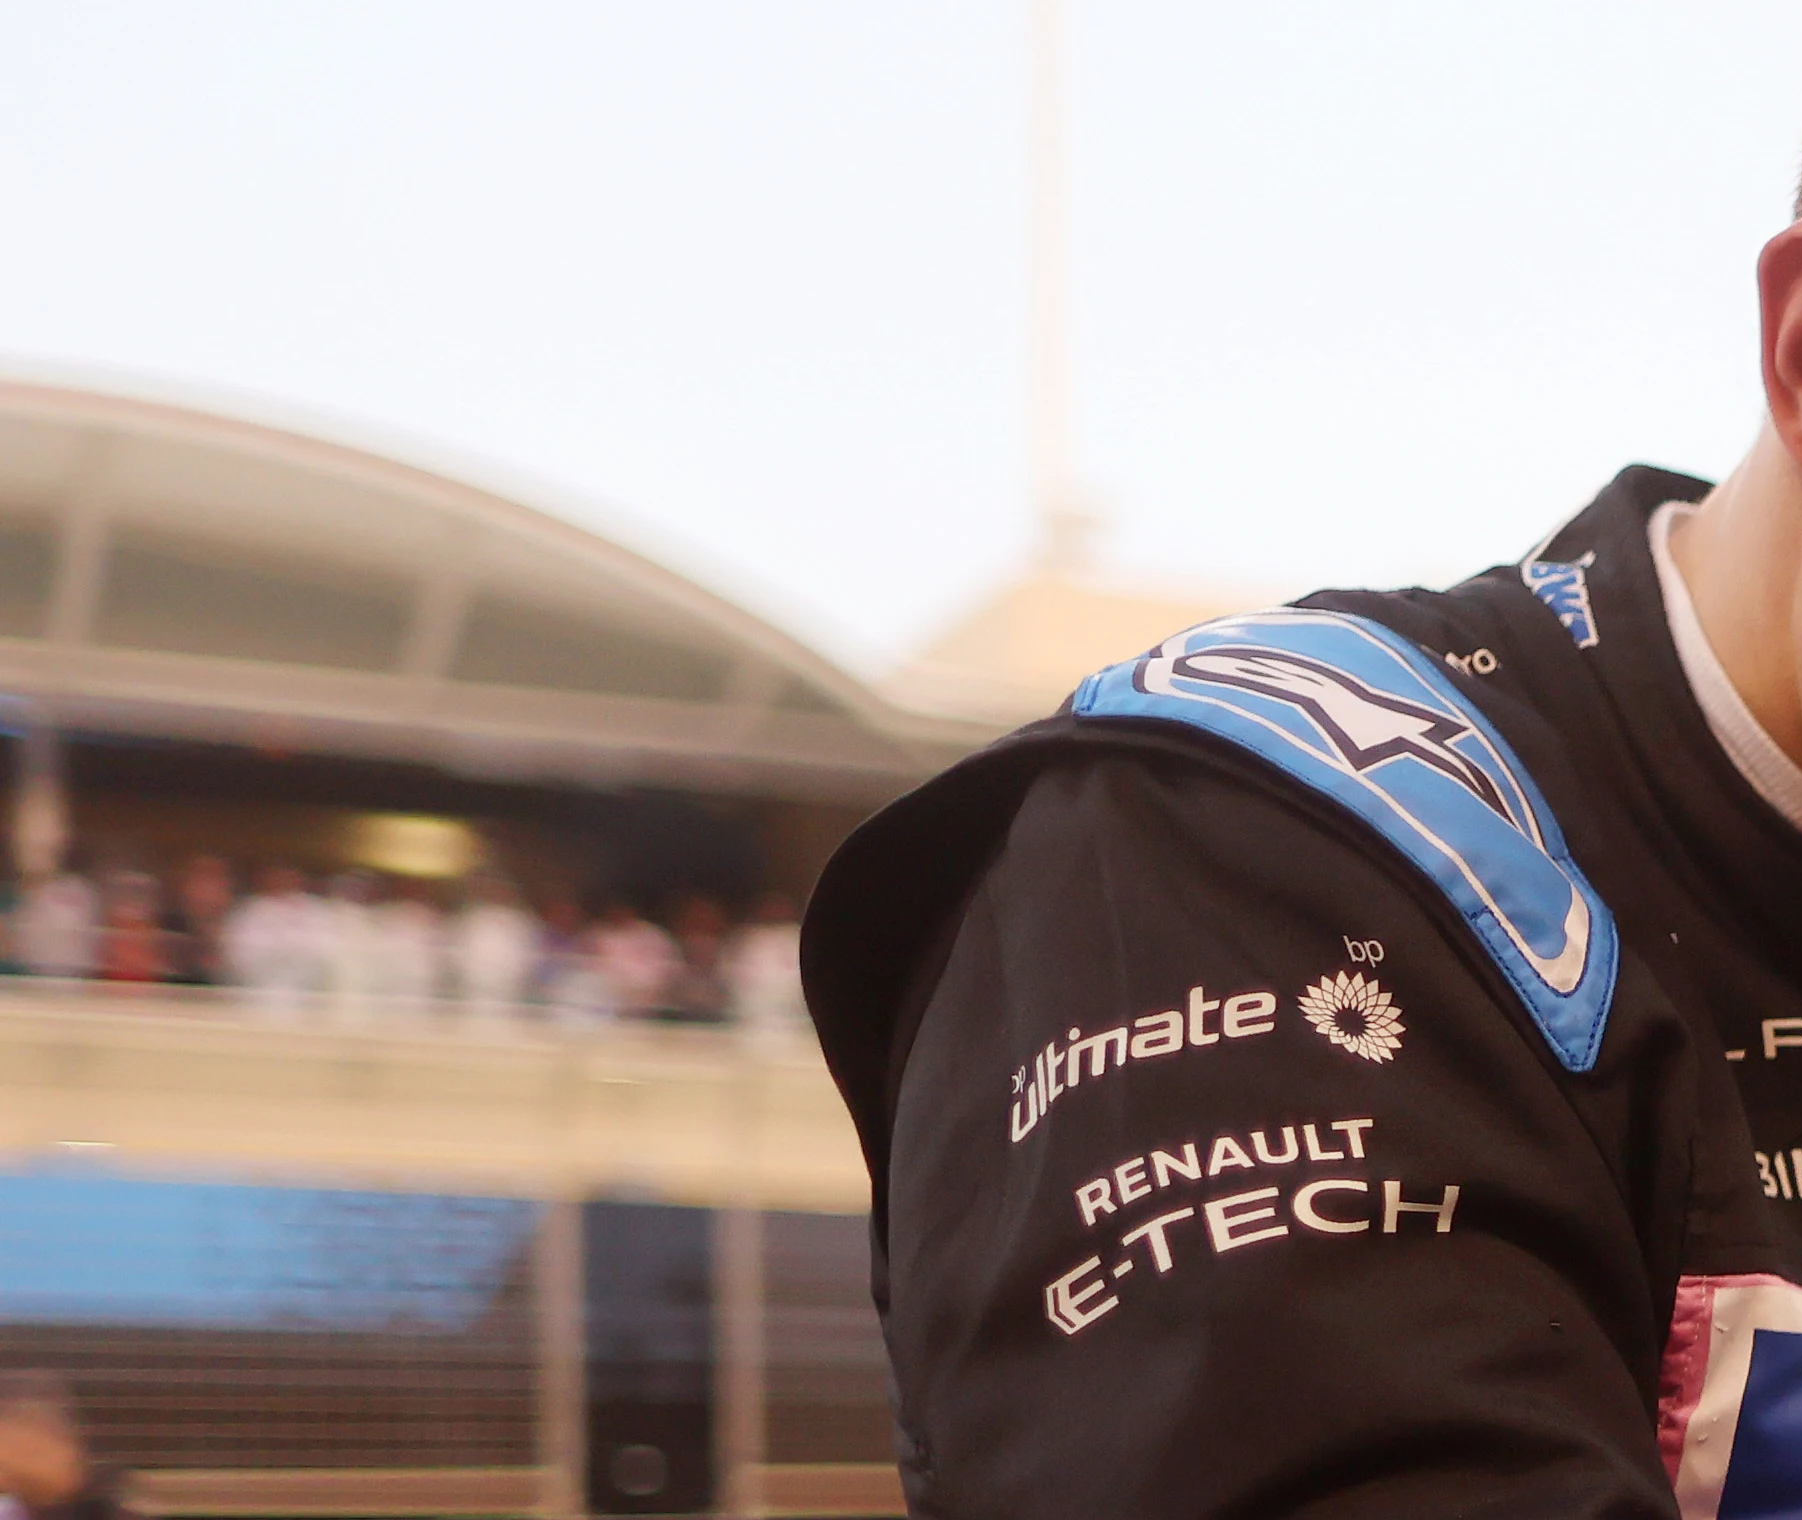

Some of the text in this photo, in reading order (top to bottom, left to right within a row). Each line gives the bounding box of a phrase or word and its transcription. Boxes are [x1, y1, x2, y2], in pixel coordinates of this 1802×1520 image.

[1343, 935, 1385, 967] bp
[1010, 985, 1277, 1144] ultimate
[1074, 1117, 1374, 1227] RENAULT
[1045, 1178, 1461, 1336] E-TECH
